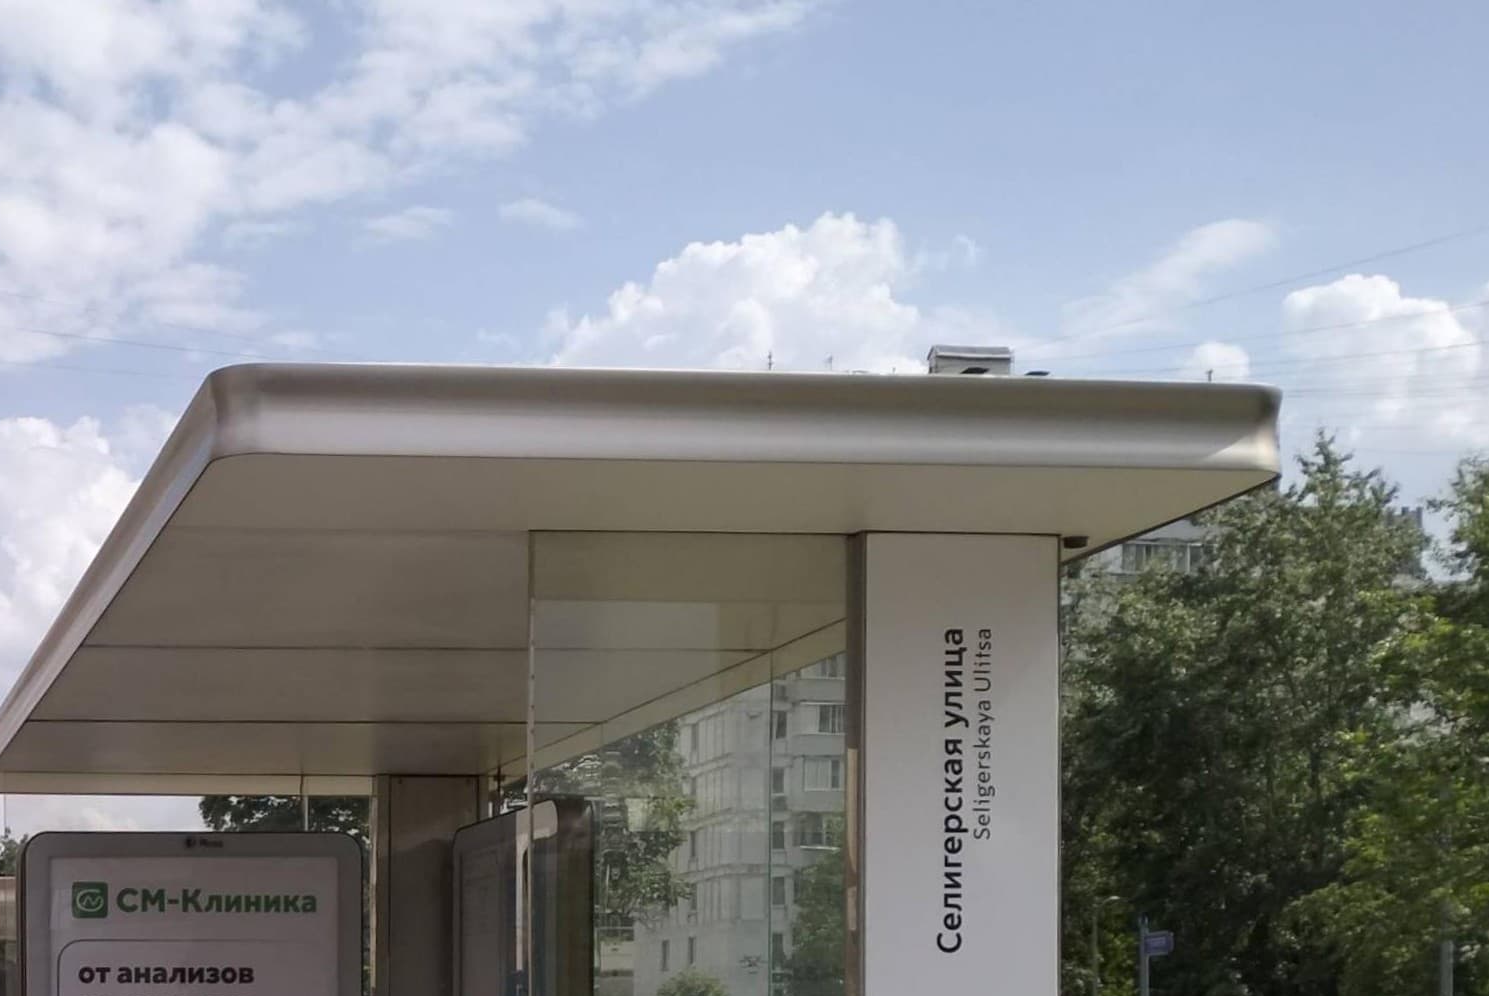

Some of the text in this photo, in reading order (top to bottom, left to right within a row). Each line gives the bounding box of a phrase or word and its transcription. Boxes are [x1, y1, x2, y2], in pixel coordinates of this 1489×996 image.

[937, 628, 969, 954] Селигерская улица
[973, 628, 995, 840] Seligerskaya Ulitsa
[116, 888, 318, 913] СМ-Клиника
[78, 966, 254, 984] от анализов
